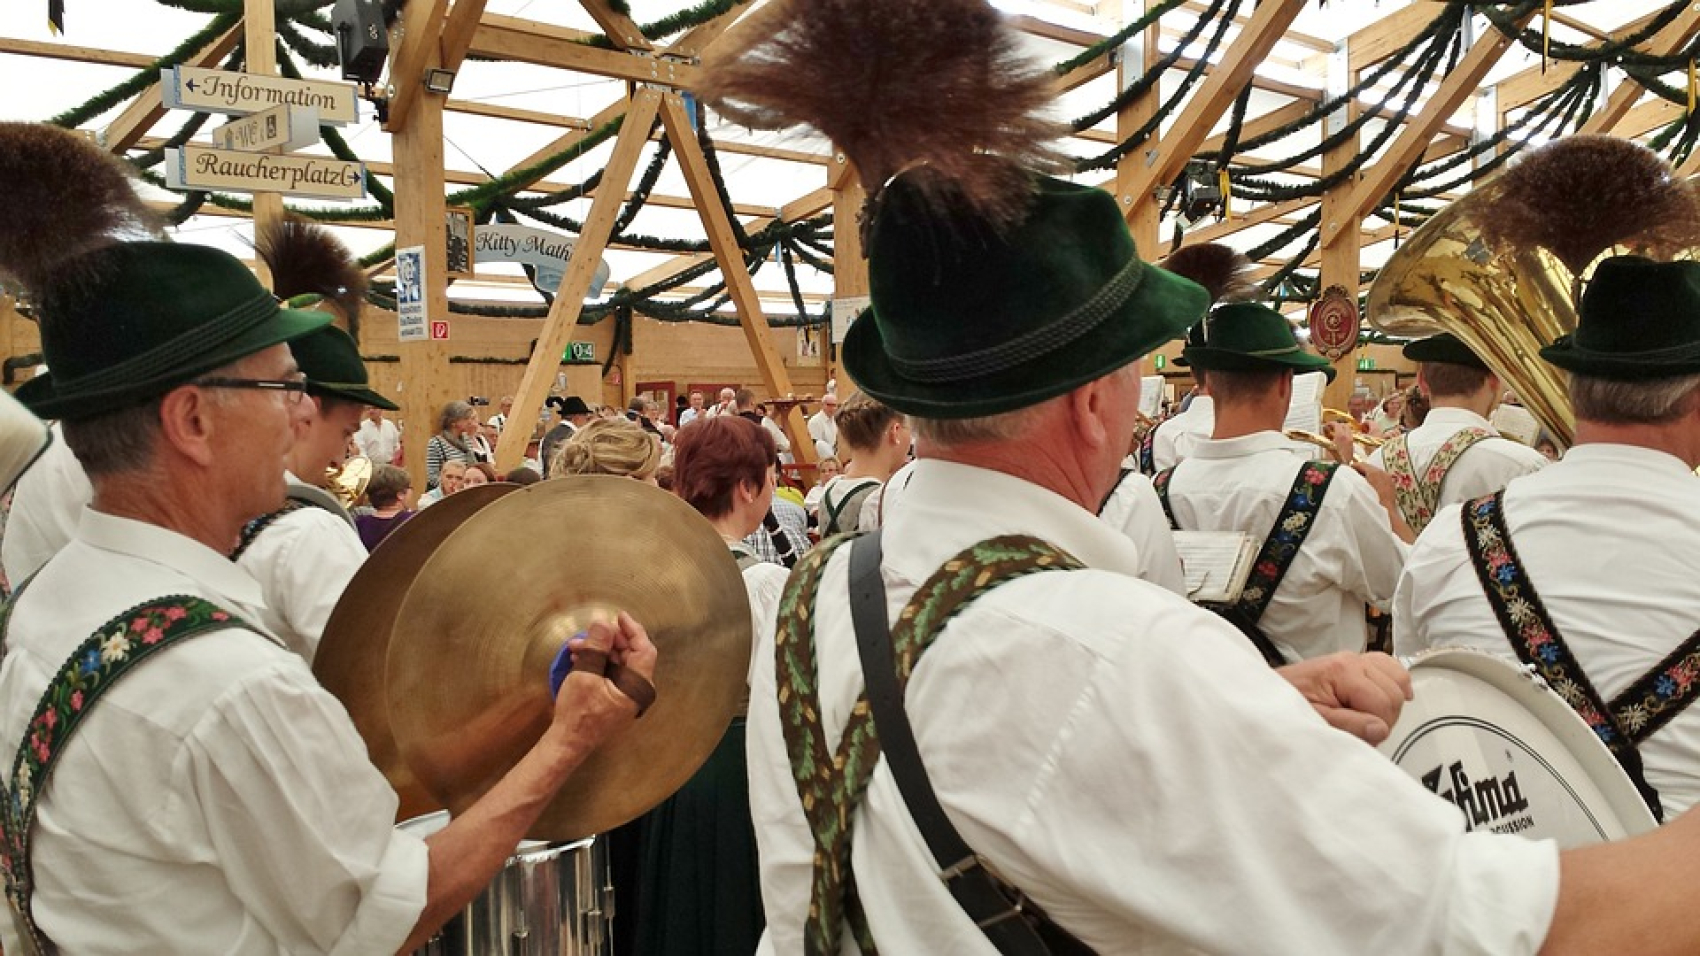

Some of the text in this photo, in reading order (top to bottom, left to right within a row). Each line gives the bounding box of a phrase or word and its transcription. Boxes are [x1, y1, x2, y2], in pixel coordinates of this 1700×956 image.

[202, 75, 336, 111] Information
[196, 153, 353, 189] Raucherplatzl
[476, 231, 573, 262] Kitty Math
